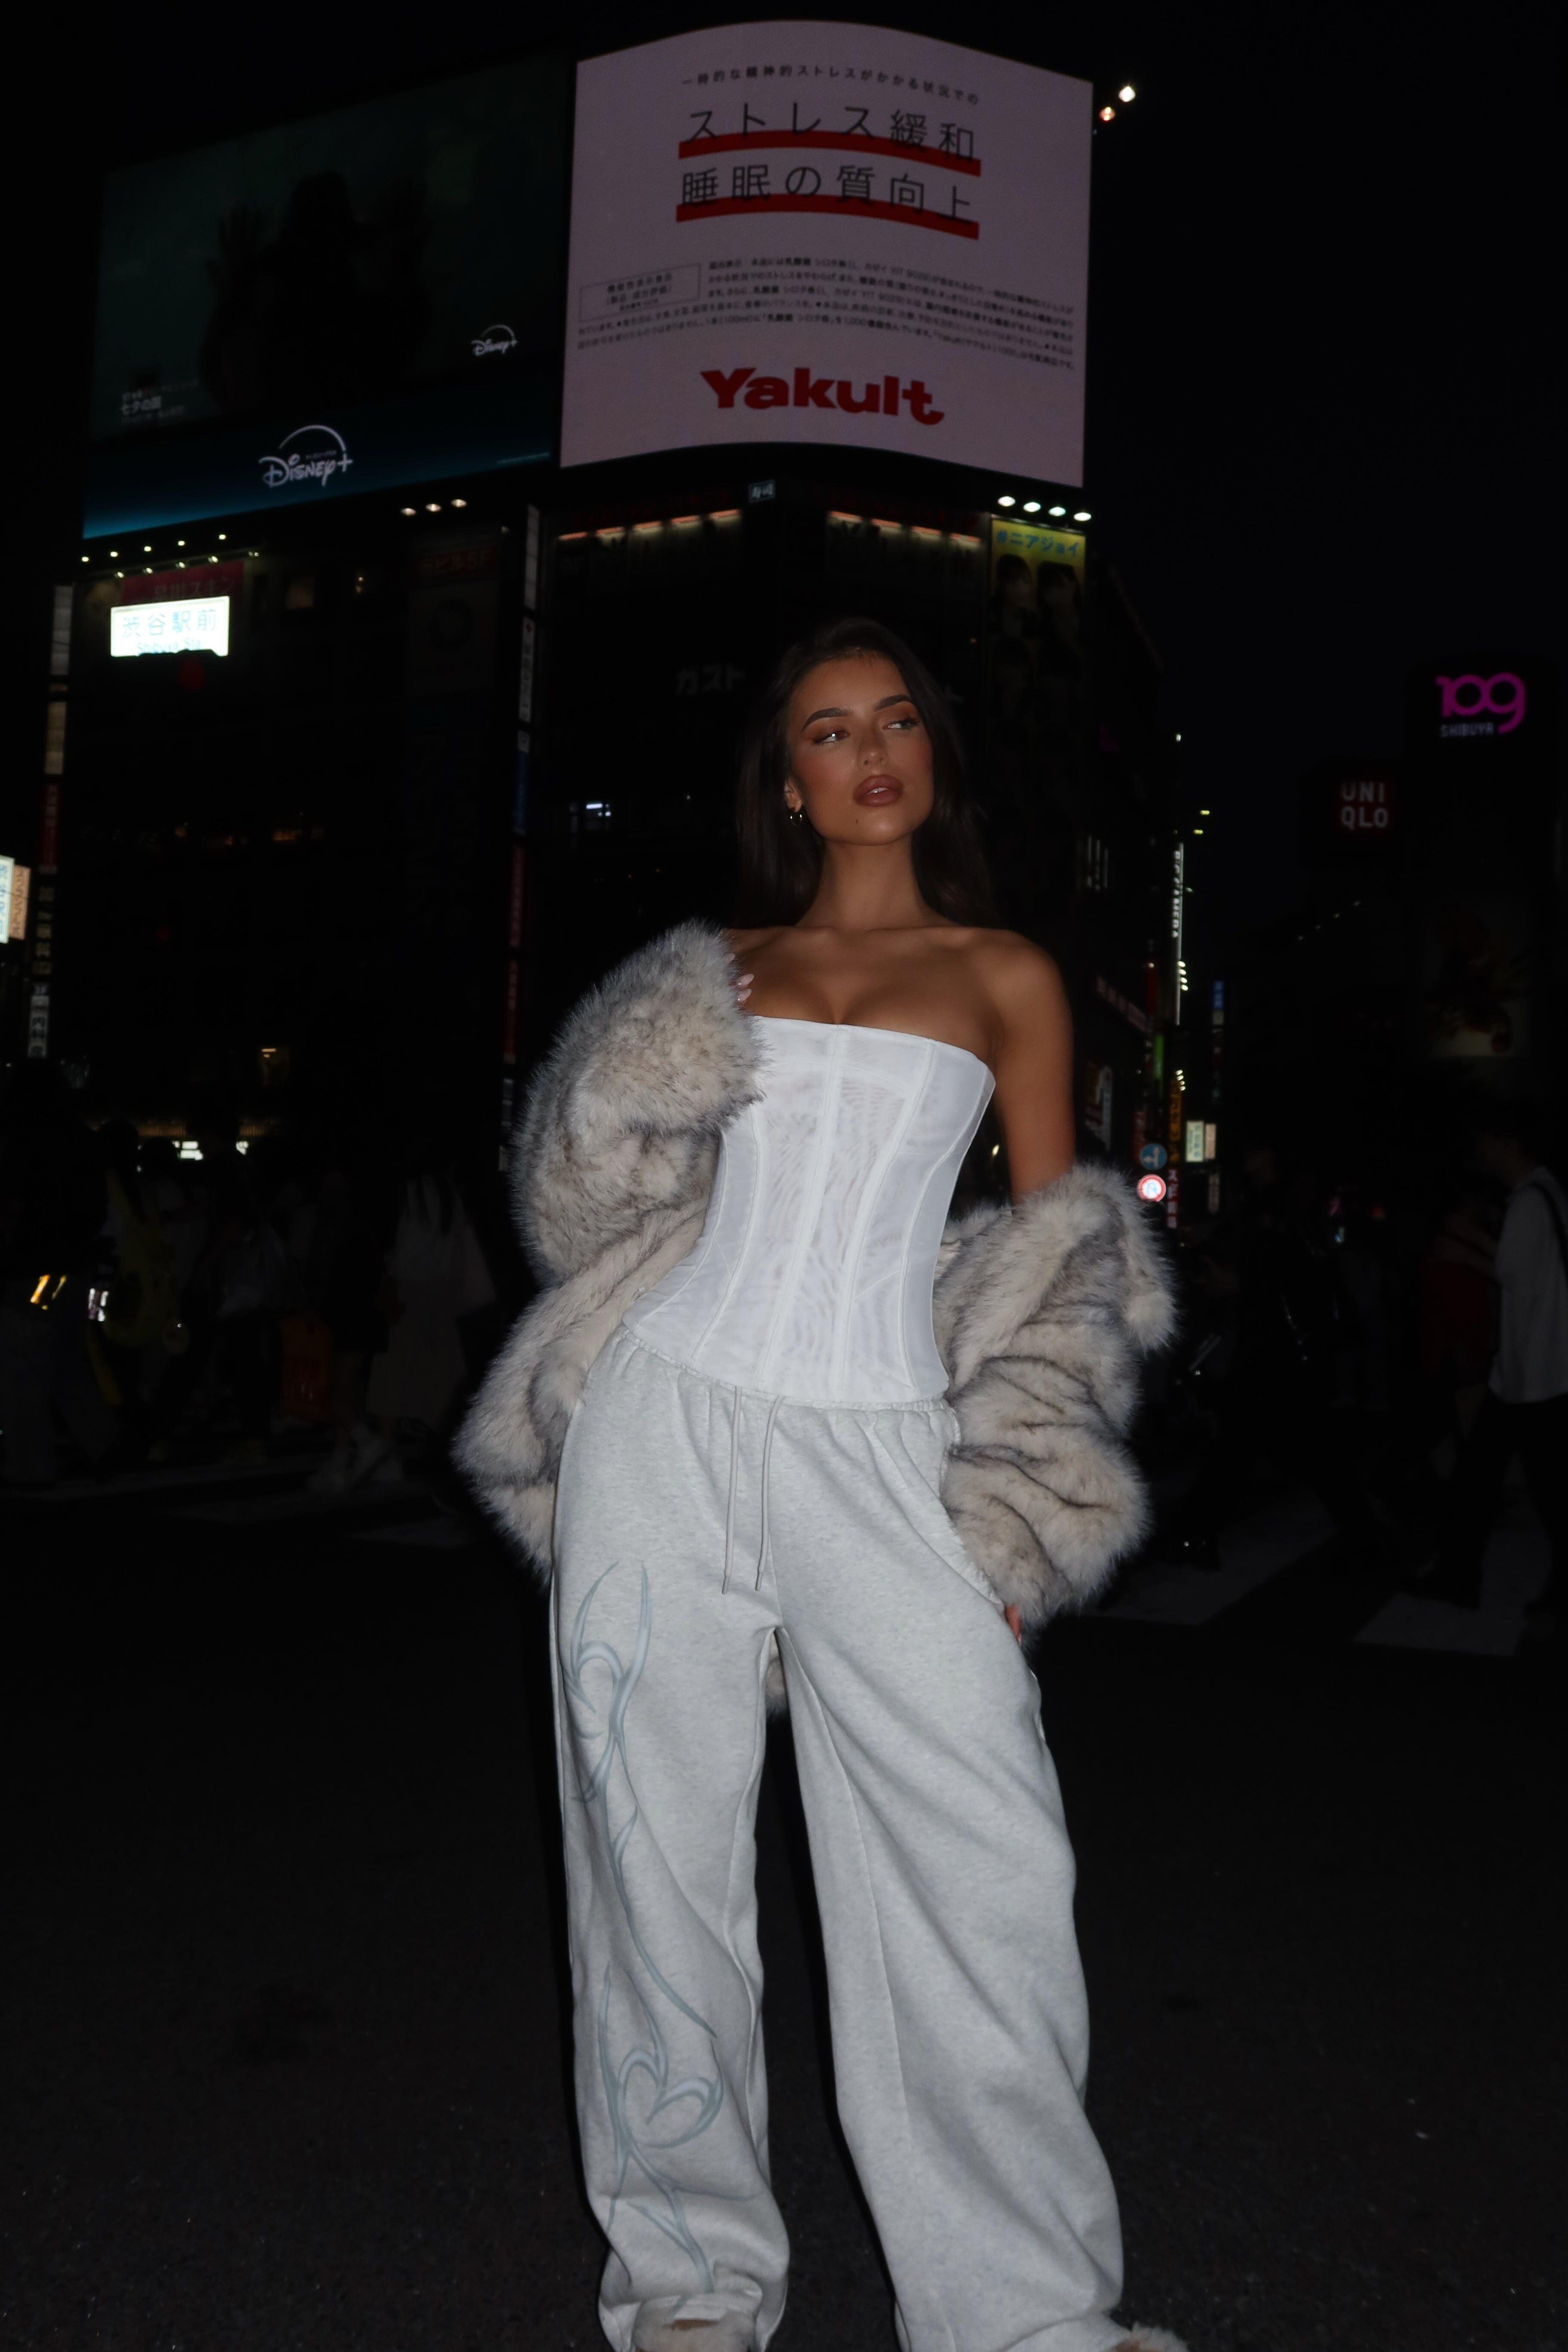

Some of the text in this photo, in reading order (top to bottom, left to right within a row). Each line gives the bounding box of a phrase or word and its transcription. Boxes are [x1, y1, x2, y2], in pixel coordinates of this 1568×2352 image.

[685, 102, 974, 162] ストレス緩和
[681, 164, 973, 224] 睡眠の質向上
[701, 367, 944, 425] Yakult
[122, 608, 217, 638] 渋谷駅前
[1434, 672, 1526, 735] 109
[1439, 722, 1494, 738] SHIBUYA
[1340, 781, 1386, 803] UNI
[1340, 805, 1390, 831] QLO
